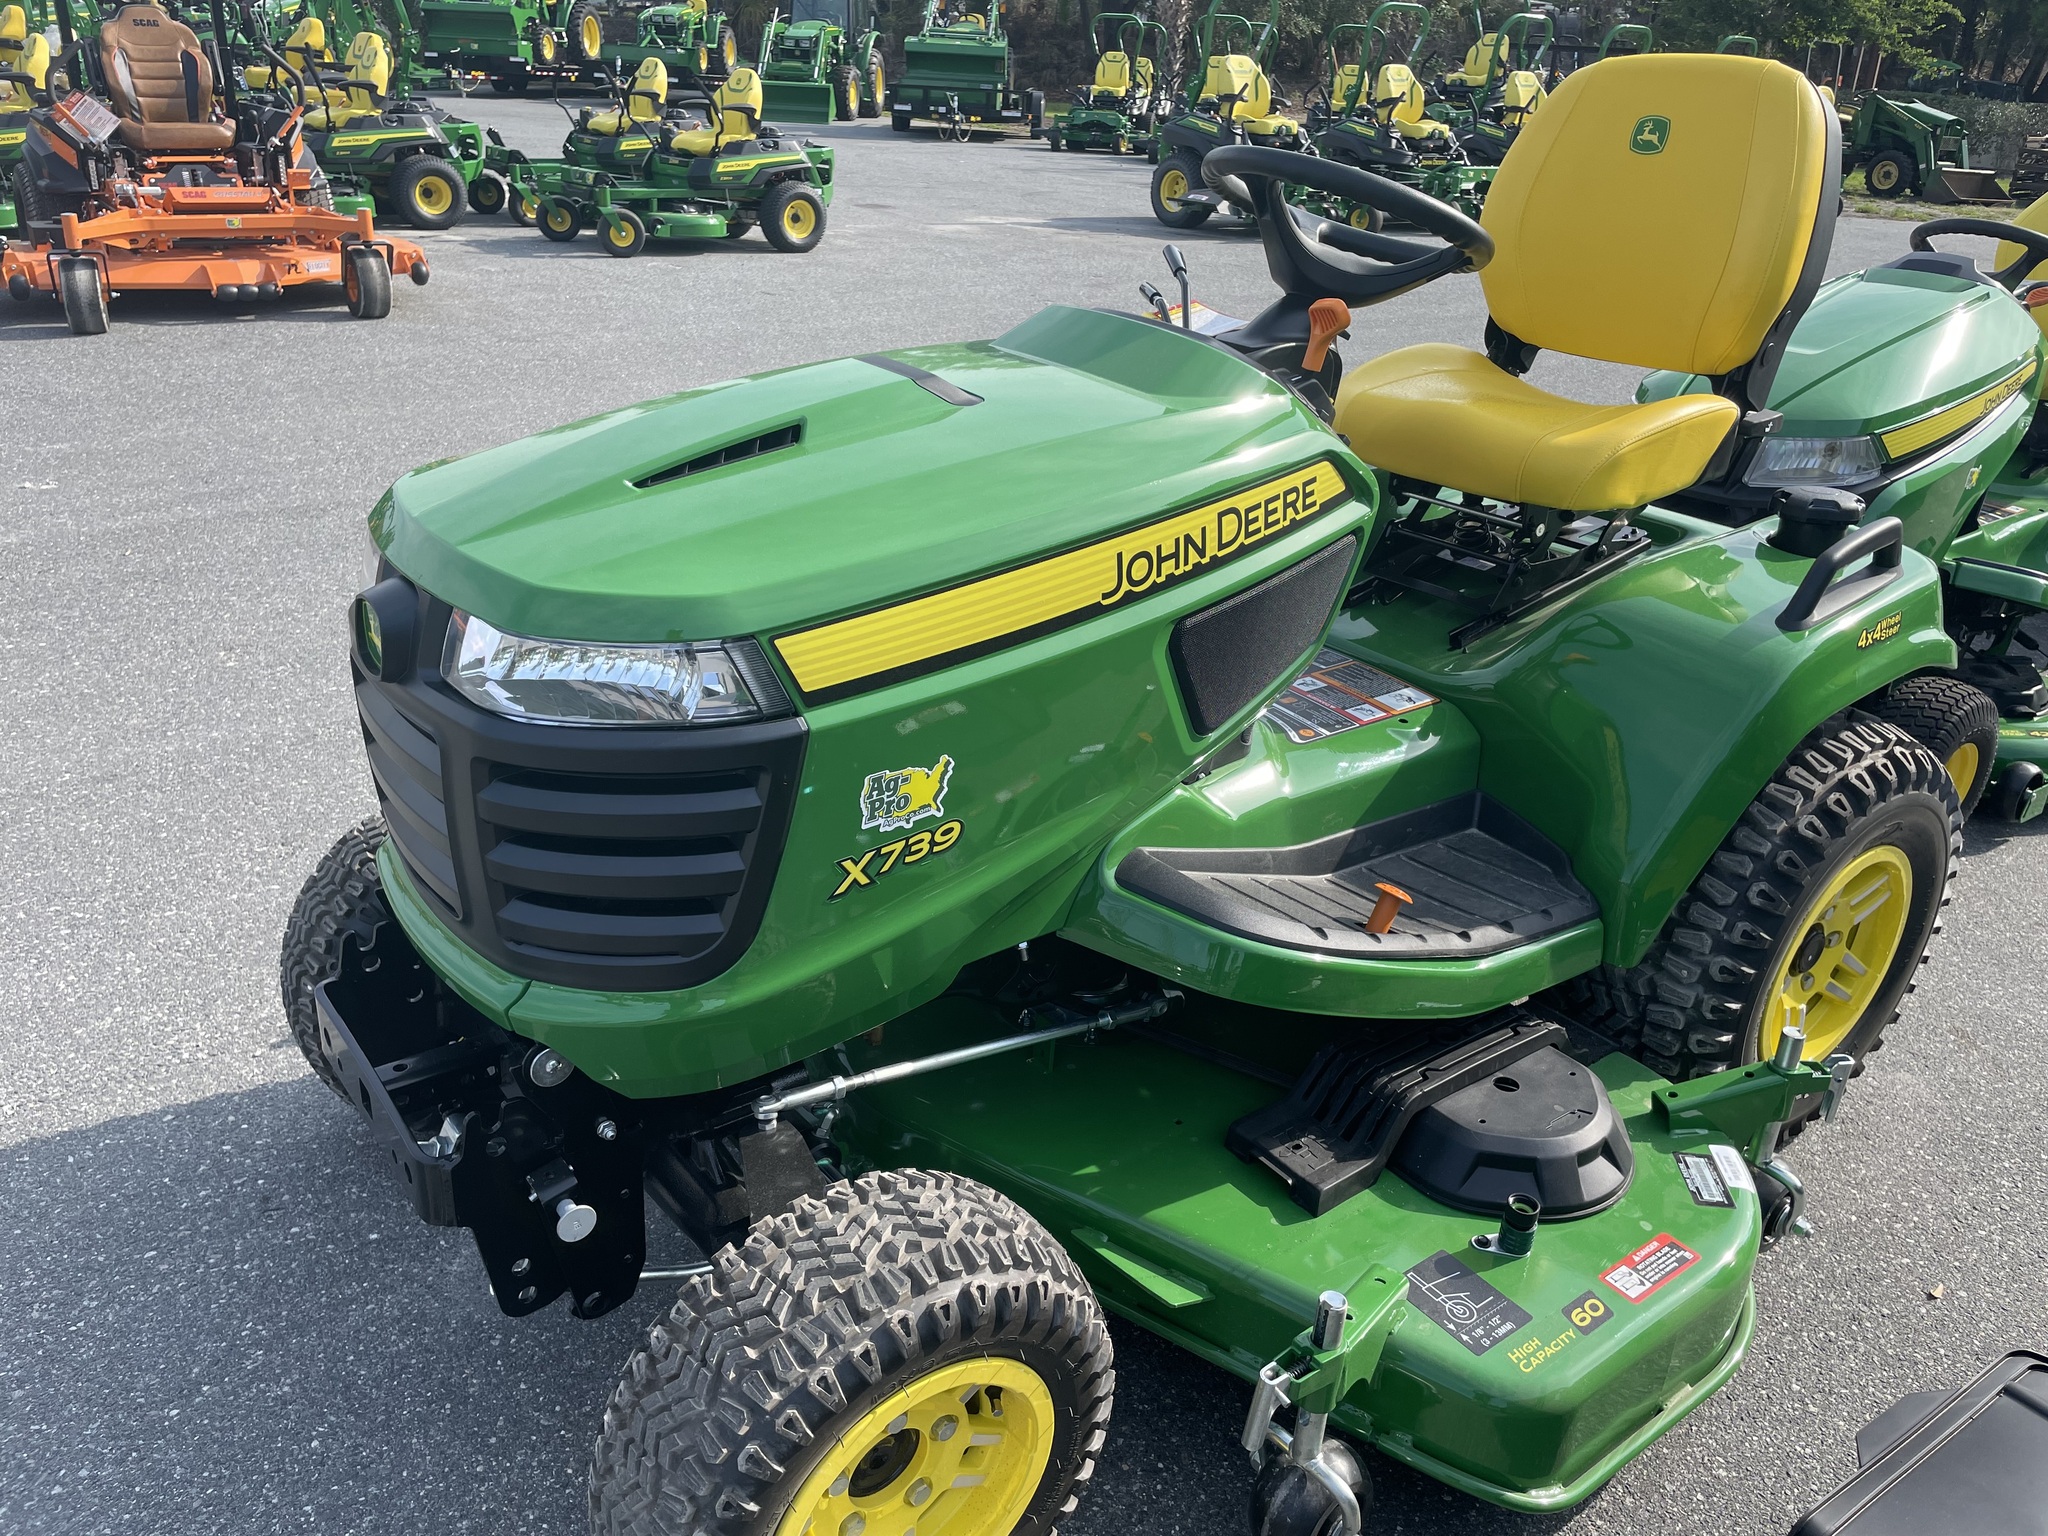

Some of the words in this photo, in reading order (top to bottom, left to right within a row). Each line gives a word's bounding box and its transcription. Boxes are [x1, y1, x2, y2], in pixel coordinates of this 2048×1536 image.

[132, 18, 160, 28] SCAG
[181, 191, 207, 199] SCAG
[1980, 389, 2003, 416] JOHN
[2002, 373, 2024, 400] DEERE
[1101, 525, 1208, 603] JOHN
[1216, 475, 1320, 554] DEERE
[1857, 622, 1881, 648] 4x4
[1881, 610, 1902, 630] Wheel
[1880, 623, 1901, 641] Steer
[866, 772, 912, 801] Ag-
[864, 792, 913, 825] Pro
[882, 806, 931, 828] AgProCo.com
[830, 820, 964, 899] X739
[1636, 1240, 1661, 1258] DANGER
[1636, 1254, 1659, 1270] ROTATING
[1655, 1245, 1671, 1257] BLADE
[1570, 1298, 1605, 1327] 60
[1507, 1336, 1542, 1363] HIGH
[1519, 1327, 1576, 1373] CAPACITY
